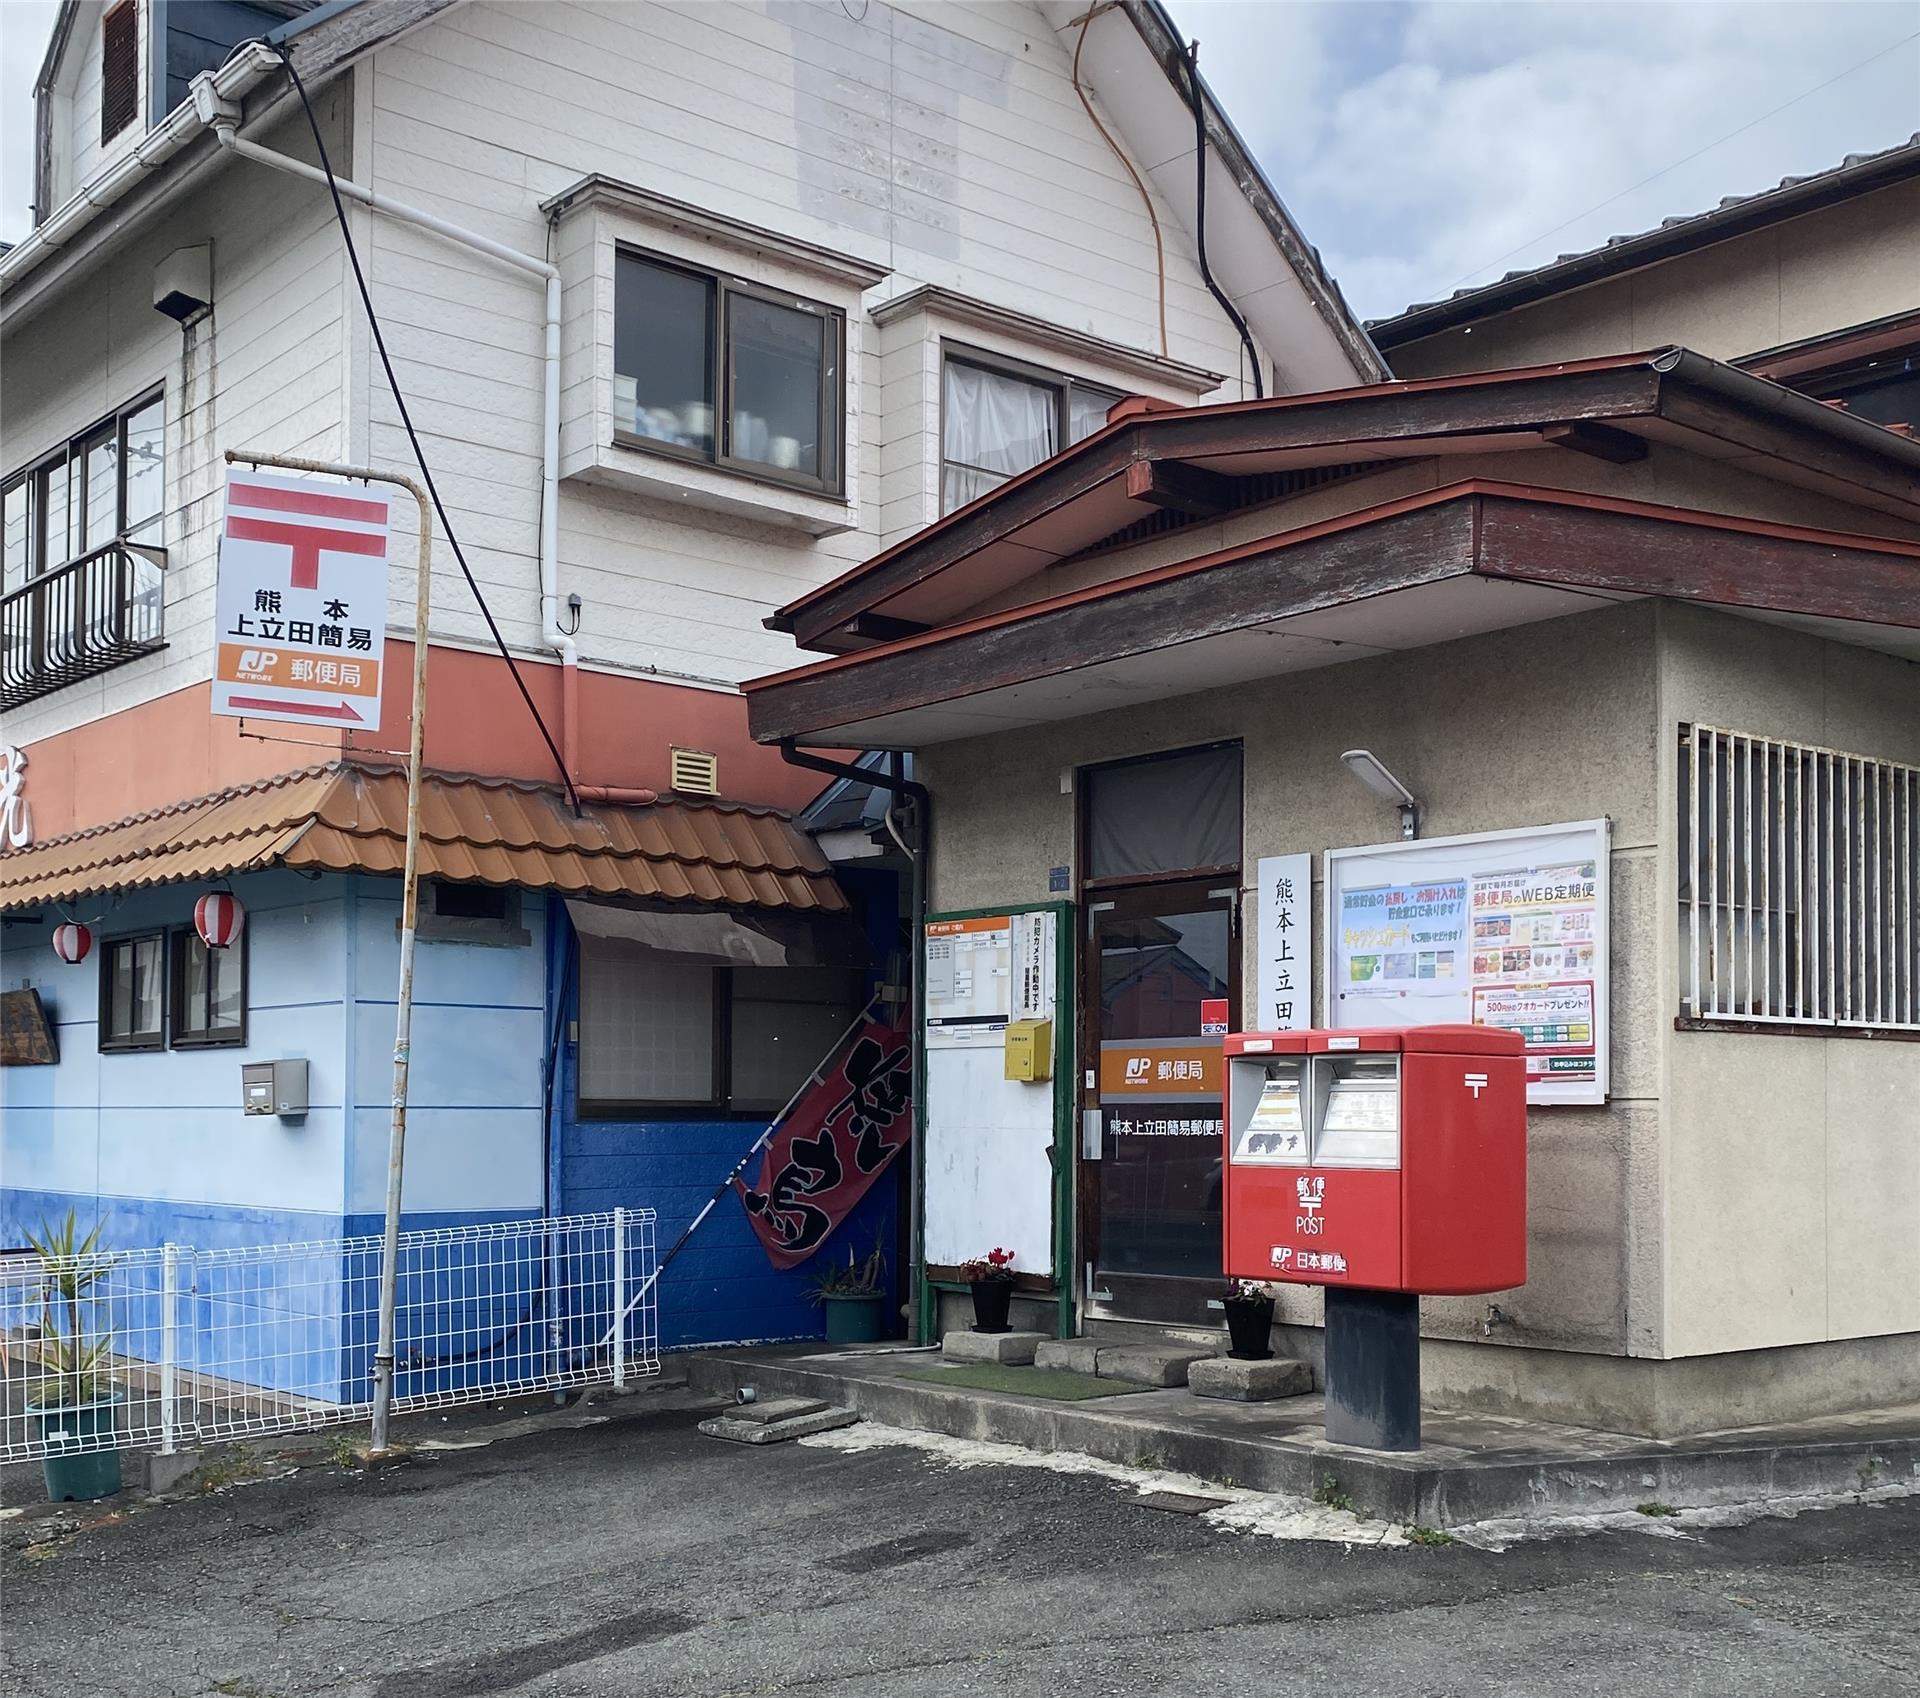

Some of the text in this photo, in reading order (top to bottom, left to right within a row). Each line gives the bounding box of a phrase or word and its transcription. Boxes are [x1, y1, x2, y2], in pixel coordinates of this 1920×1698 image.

[228, 614, 372, 651] 上立田簡易
[235, 671, 273, 682] NETWORK
[238, 649, 361, 688] JP 郵便局
[1473, 881, 1595, 907] 郵便局のWEB定期便
[1032, 917, 1041, 1012] 防犯カメラ作動中です
[1274, 878, 1295, 1031] 熊本上立田
[1203, 1024, 1227, 1033] SECOM
[1126, 1058, 1203, 1081] JP 郵便局
[1554, 1060, 1593, 1068] お申込みはコチラ
[1110, 1119, 1224, 1137] 熊本上立田簡易郵便局
[1296, 1176, 1325, 1198] 郵便
[1296, 1216, 1325, 1235] POST
[1271, 1246, 1347, 1272] JP 日本郵便
